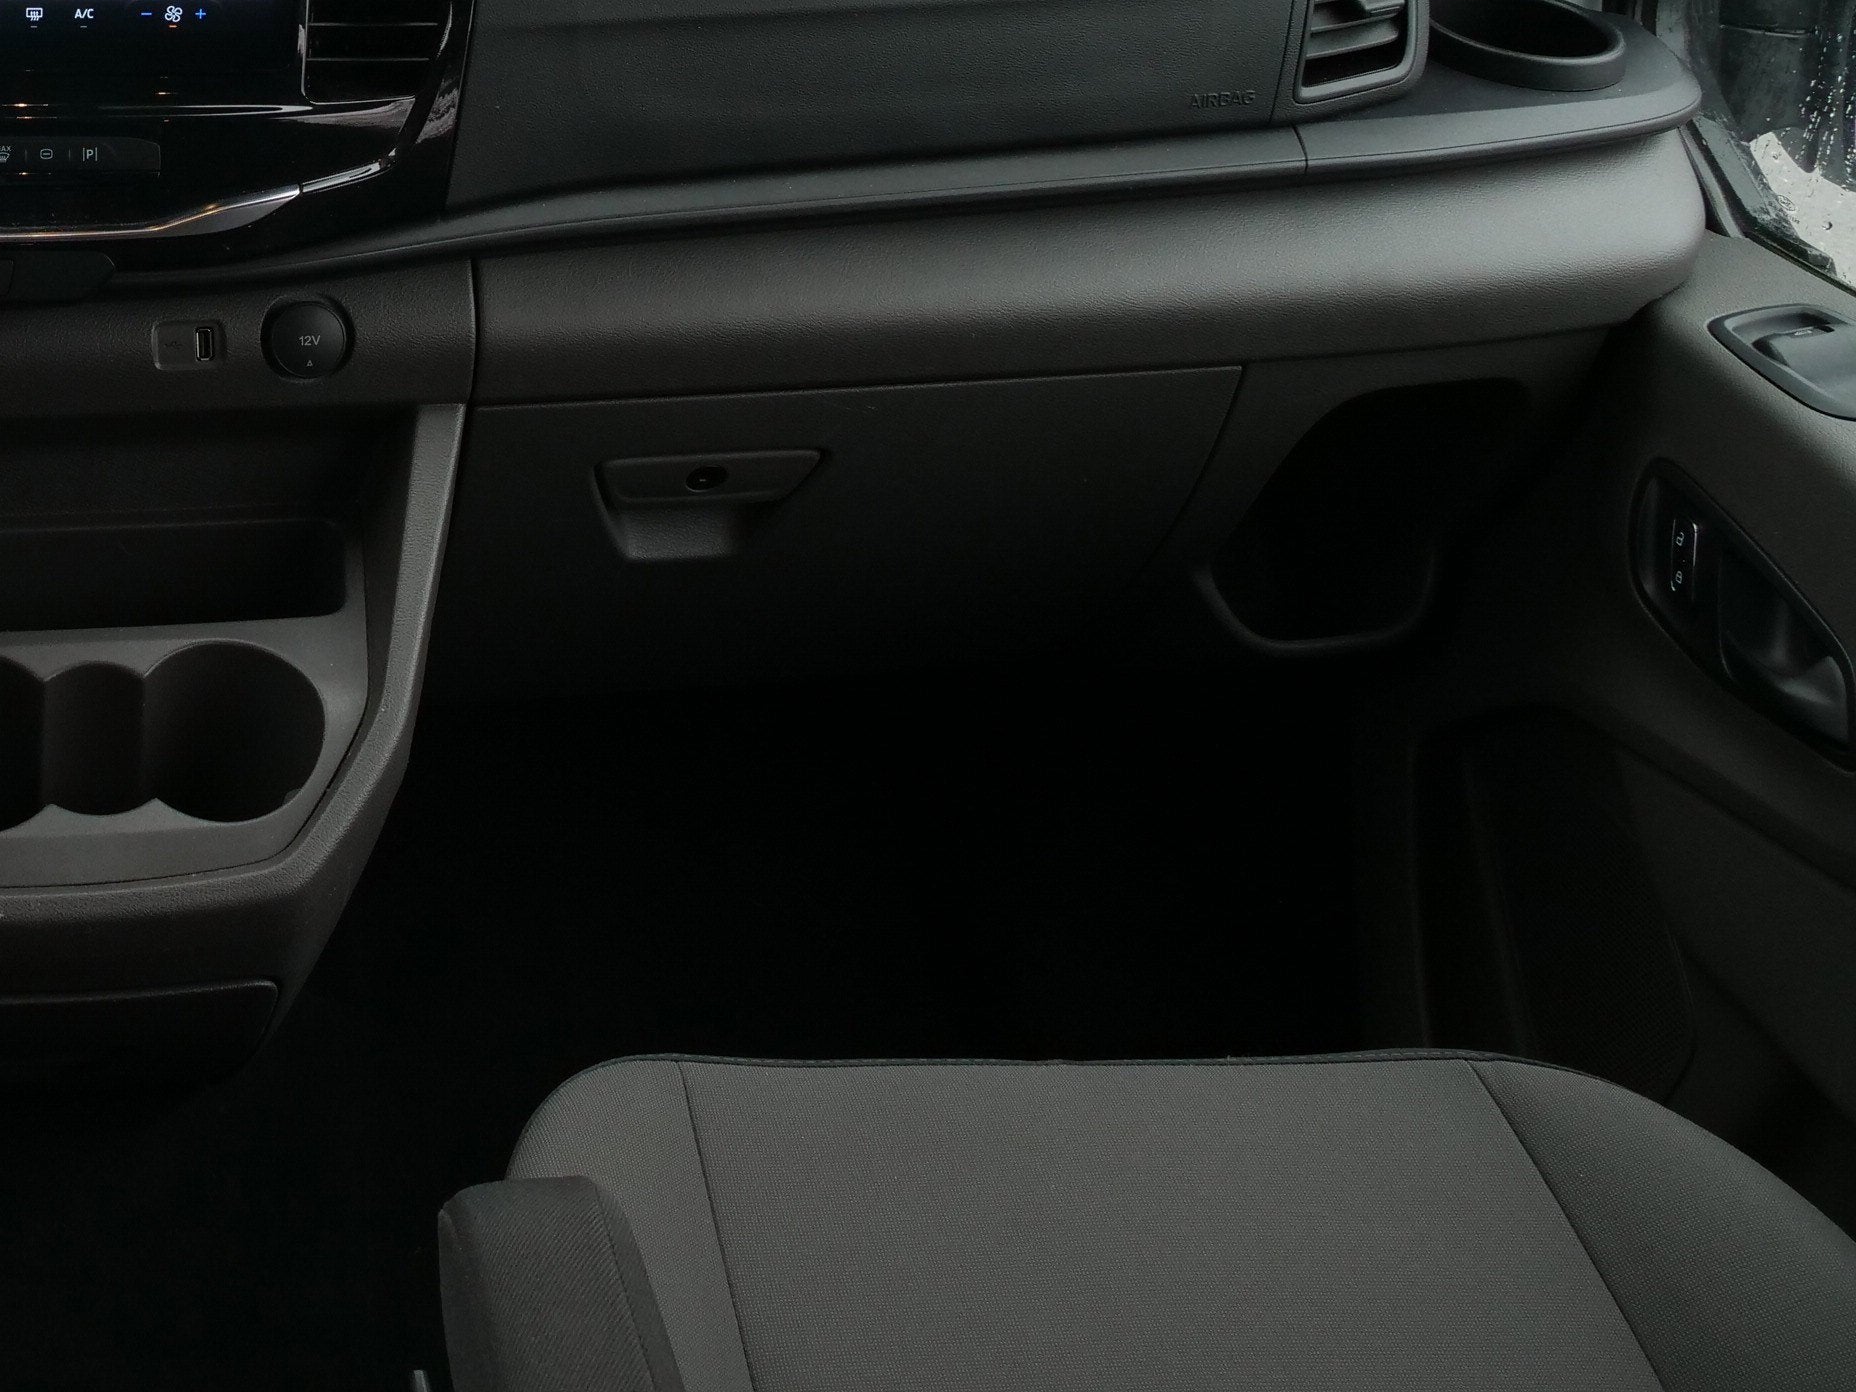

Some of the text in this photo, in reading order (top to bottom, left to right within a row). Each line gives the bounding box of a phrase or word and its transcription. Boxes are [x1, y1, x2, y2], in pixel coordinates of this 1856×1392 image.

[74, 8, 94, 19] A/C
[1191, 89, 1256, 108] AIRBAG
[298, 334, 321, 346] 12V
